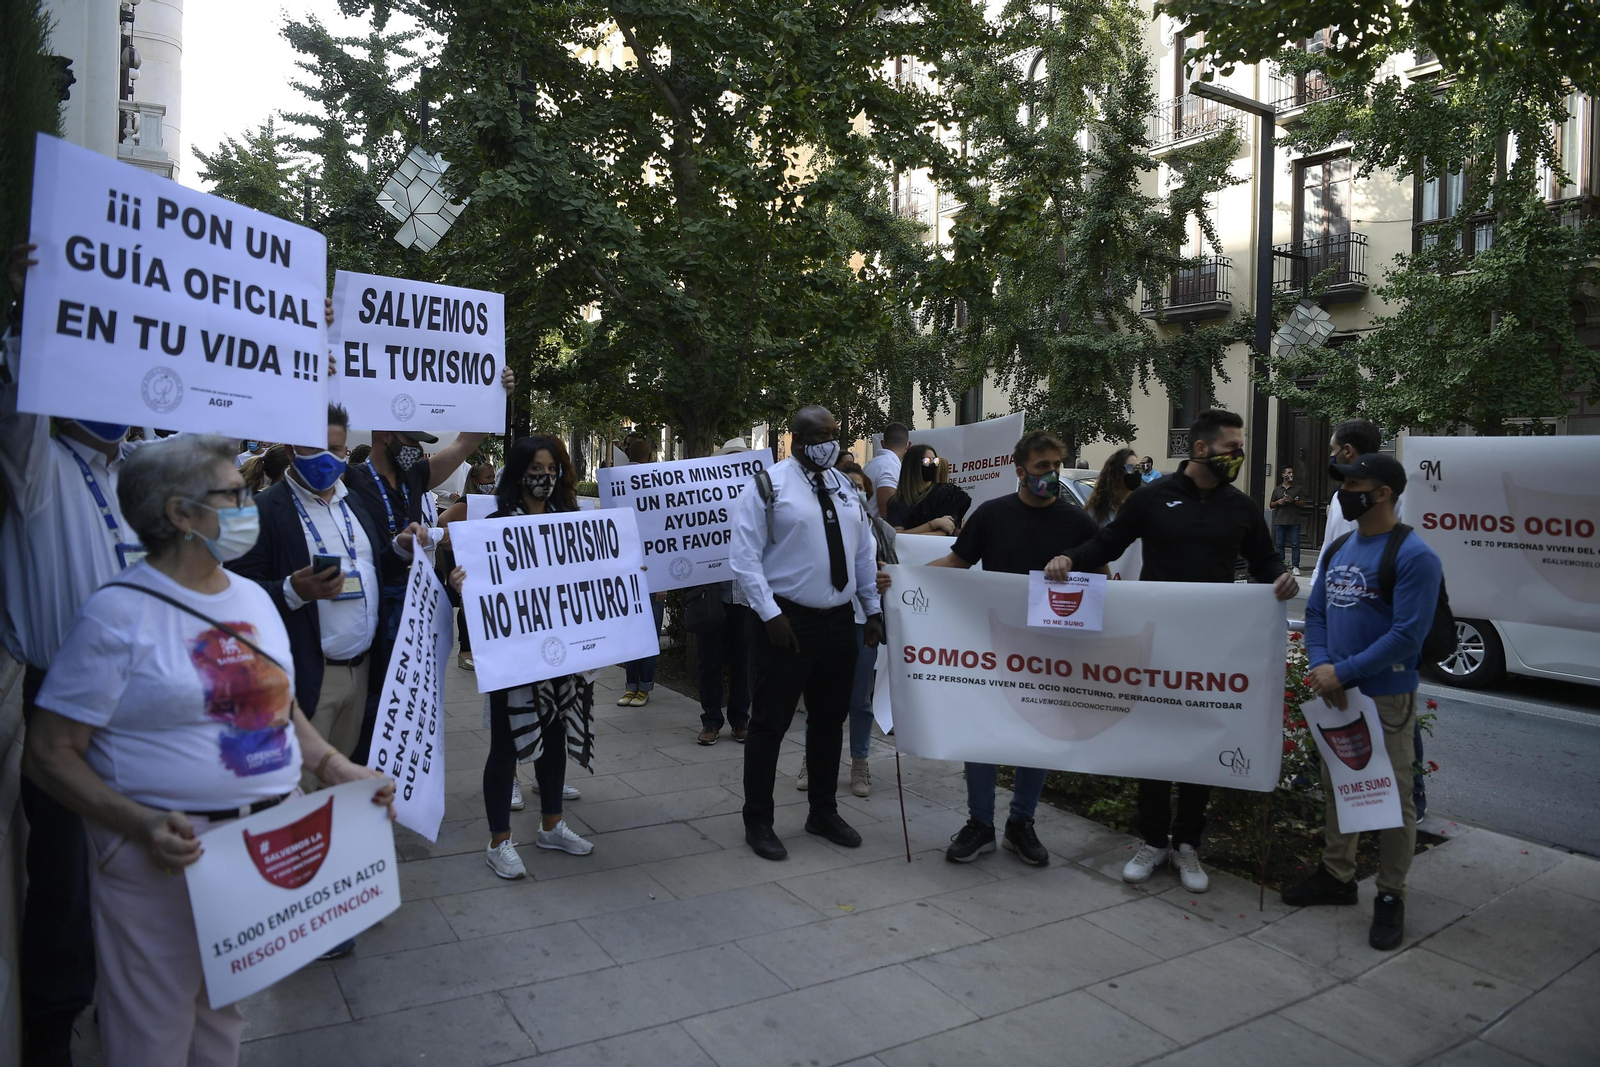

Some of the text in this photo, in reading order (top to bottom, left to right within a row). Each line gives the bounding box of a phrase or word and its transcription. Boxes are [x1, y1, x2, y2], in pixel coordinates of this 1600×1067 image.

[156, 197, 233, 250] PON
[246, 226, 291, 268] UN
[65, 235, 318, 329] GUÍA OFICIAL
[358, 287, 488, 336] SALVEMOS
[56, 299, 117, 344] EN
[133, 315, 187, 356] TU
[201, 329, 282, 375] VIDA
[344, 341, 496, 386] EL TURISMO
[209, 397, 233, 408] AGIP
[630, 469, 686, 491] SEÑOR
[689, 459, 764, 483] MINISTRO
[961, 453, 1016, 473] PROBLEMA
[968, 471, 1000, 482] SOLUCIÓN
[1419, 460, 1442, 481] M
[636, 495, 660, 512] UN
[665, 487, 723, 508] RATICO
[664, 508, 728, 531] AYUDAS
[1422, 512, 1595, 538] SOMOS OCIO
[502, 525, 539, 572] SIN
[538, 518, 620, 567] TURISMO
[644, 529, 731, 556] POR FAVOR
[1497, 541, 1544, 551] PERSONAS
[1546, 545, 1574, 554] VIVEN
[1577, 547, 1595, 555] DEL
[479, 592, 512, 640] NO
[514, 586, 553, 635] HAY
[556, 575, 629, 627] FUTURO
[382, 689, 401, 742] HAY
[395, 650, 410, 685] EN
[405, 618, 415, 646] LA
[411, 560, 423, 608] VIDA
[582, 643, 596, 651] AGIP
[391, 571, 432, 794] ENA MÁS GRANDE
[903, 645, 1249, 693] SOMOS OCIO NOCTURNO
[939, 675, 986, 686] PERSONAS
[988, 679, 1016, 688] VIVEN
[1019, 682, 1035, 690] DEL
[1038, 683, 1060, 692] OCIO
[1062, 686, 1116, 699] NOCTURNO.
[1118, 693, 1182, 706] PERRAGORDA
[1185, 700, 1242, 710] GARITOBAR
[1021, 696, 1130, 714] #SALVEMOSELOCIONOCTURNO
[403, 750, 420, 801] QUE
[415, 698, 428, 745] SER
[423, 644, 431, 692] HOY
[422, 742, 433, 775] EN
[1338, 777, 1391, 795] YO ME SUMO
[264, 832, 323, 865] SALVEMOS LA
[212, 922, 265, 958] 15.000
[267, 889, 331, 930] EMPLEOS
[333, 877, 352, 894] EN
[355, 859, 386, 885] ALTO
[231, 884, 383, 975] RIESGO DE EXTINCIÓN.
